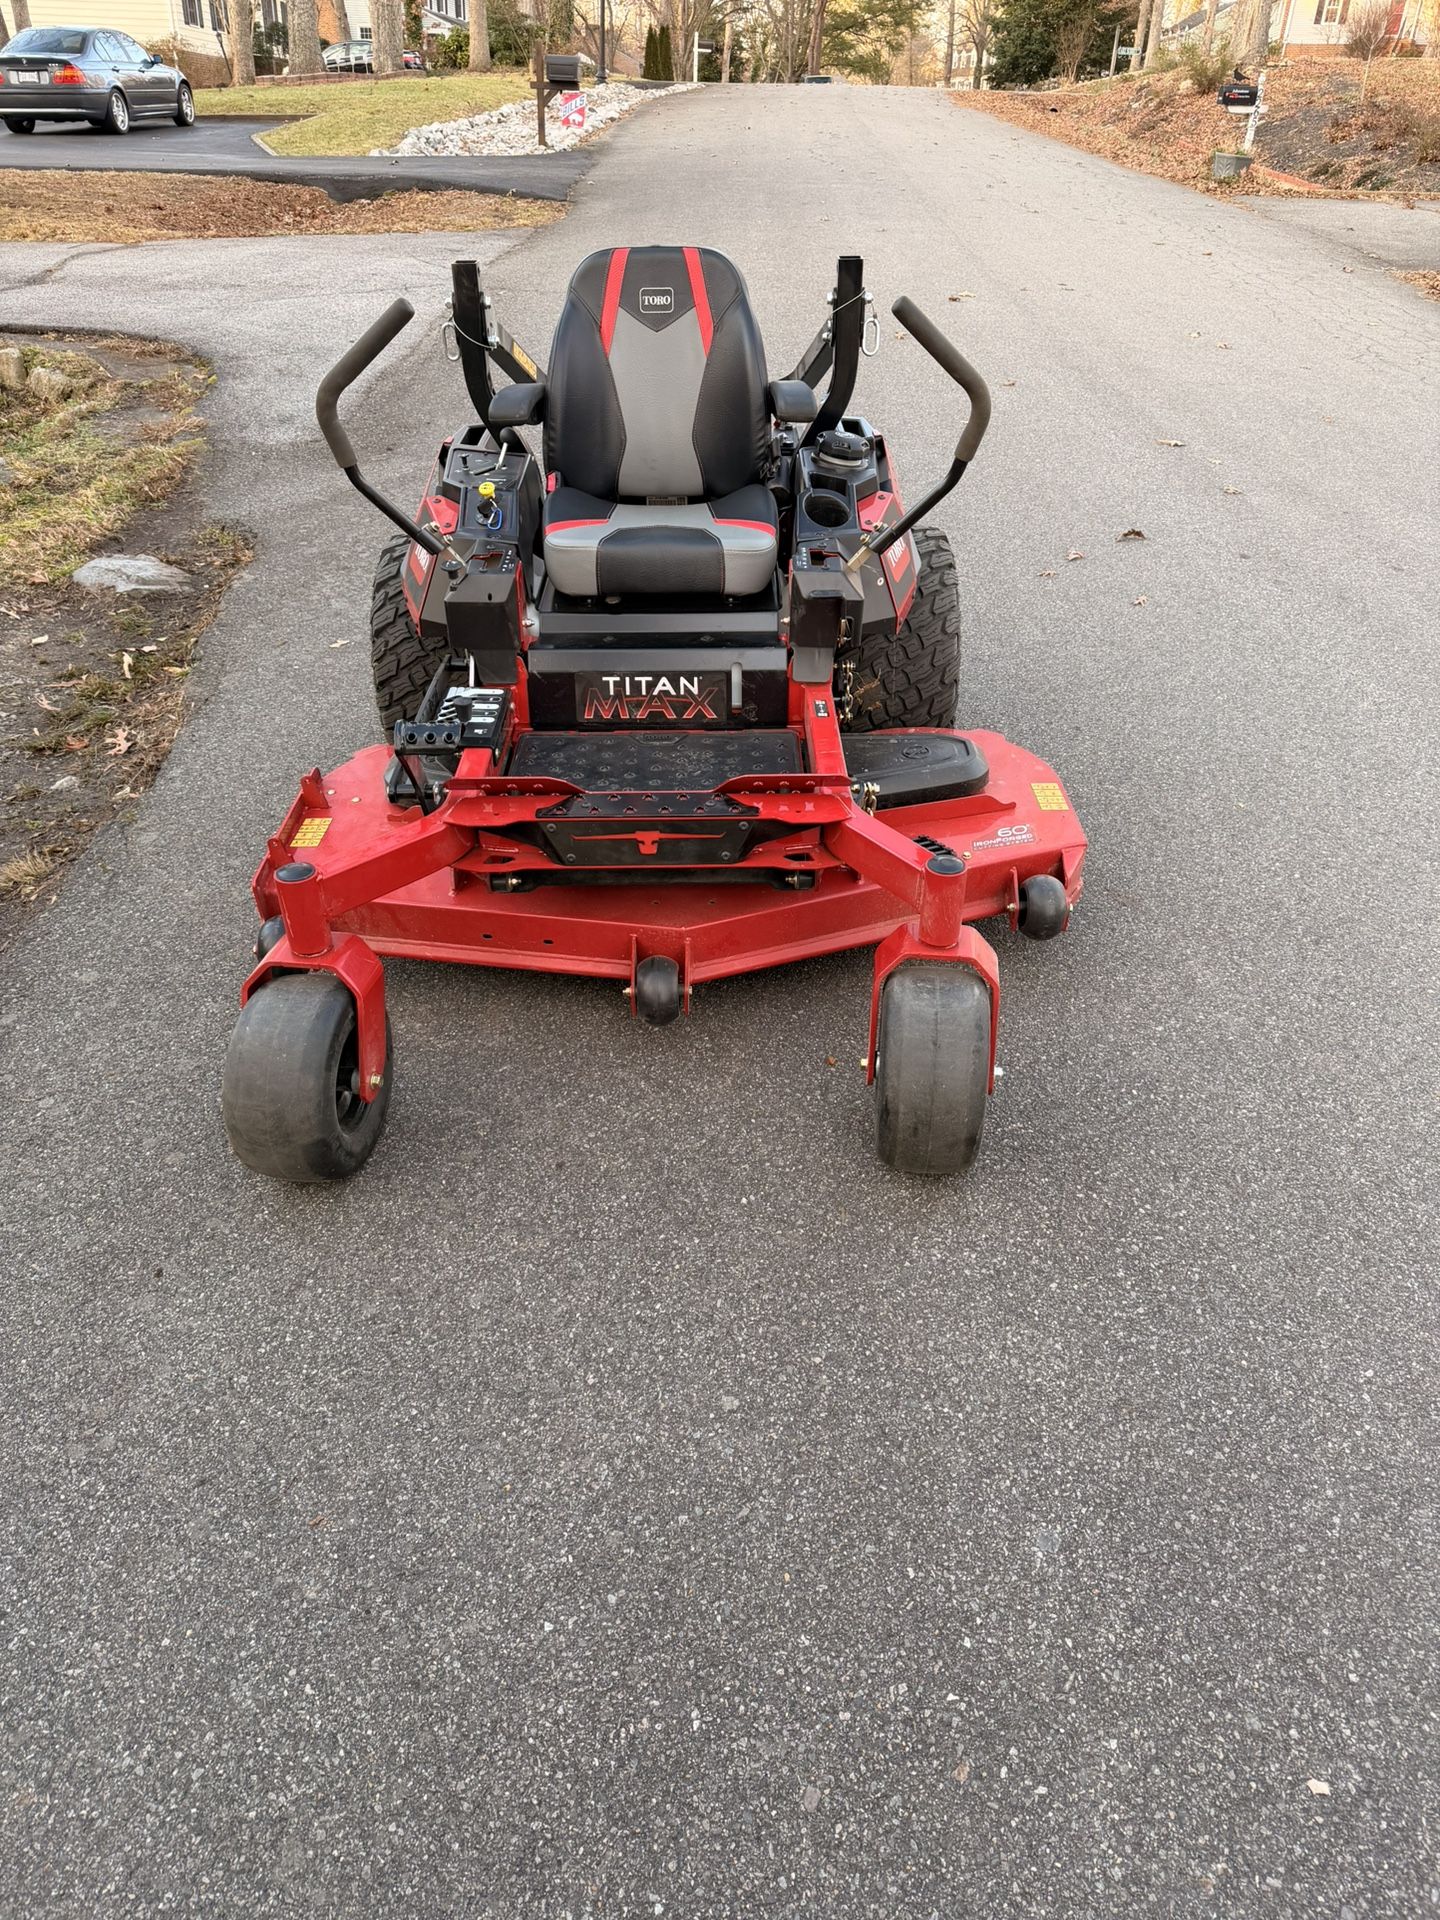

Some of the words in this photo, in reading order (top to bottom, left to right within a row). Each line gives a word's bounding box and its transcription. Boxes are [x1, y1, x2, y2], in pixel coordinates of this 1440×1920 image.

[562, 95, 586, 118] BILLS
[642, 295, 671, 305] TORO
[602, 676, 699, 696] TITAN
[584, 687, 719, 719] MAX
